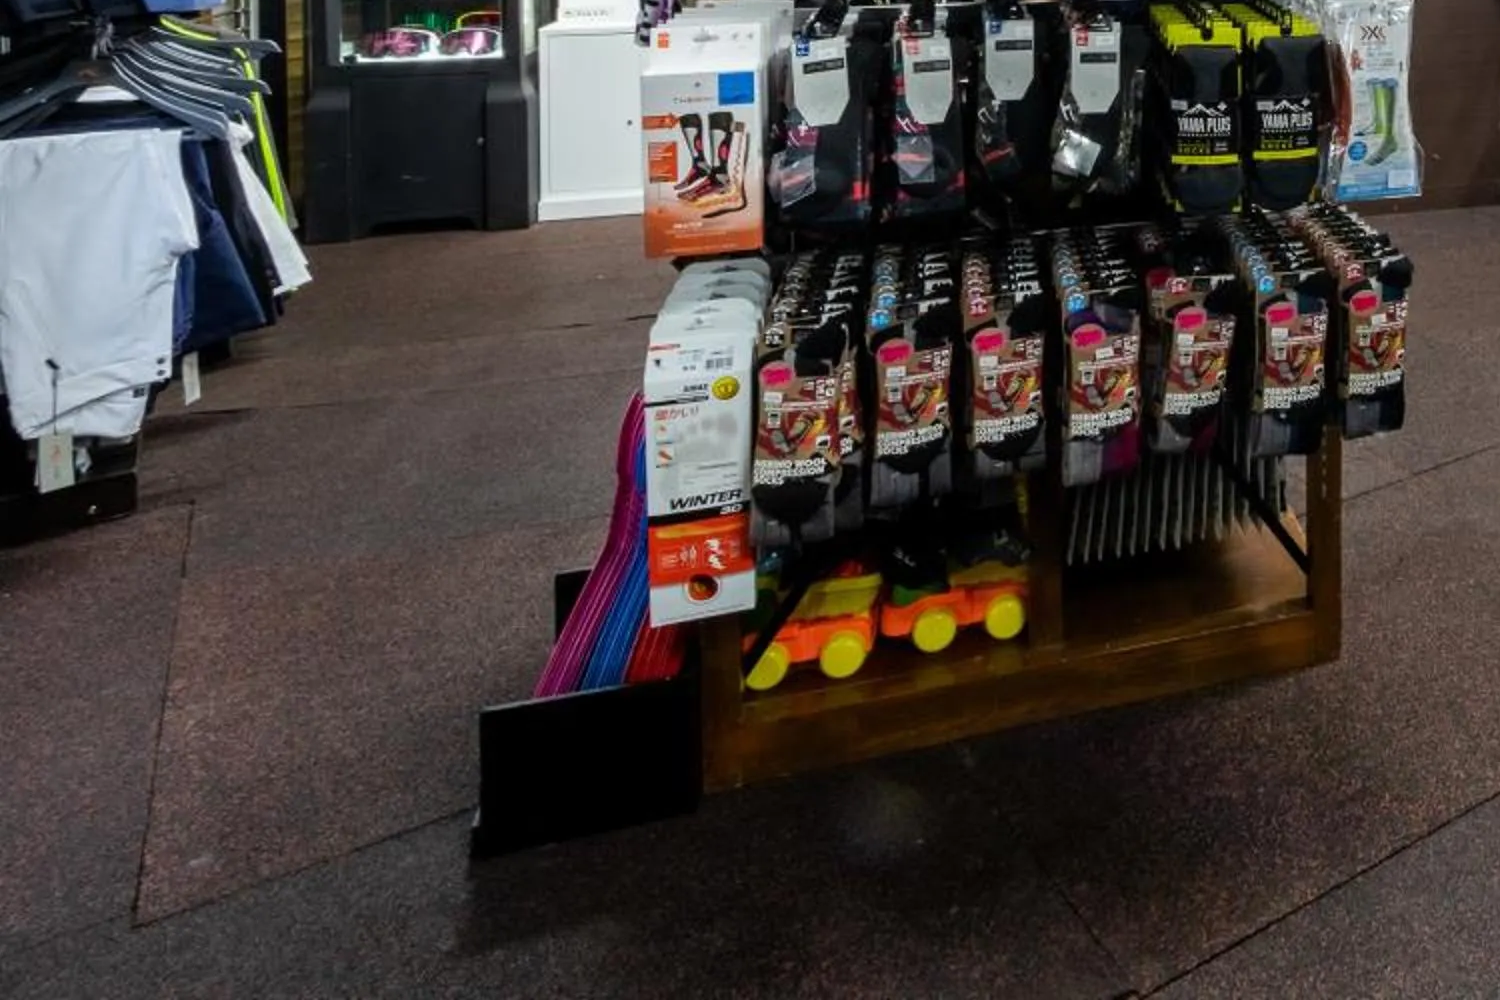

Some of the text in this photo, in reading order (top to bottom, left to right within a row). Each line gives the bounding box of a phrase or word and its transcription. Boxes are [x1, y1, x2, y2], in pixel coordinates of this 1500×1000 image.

[1177, 116, 1231, 133] YAMA PLUS
[1262, 111, 1313, 129] YAMA PLUS
[670, 488, 742, 510] WINTER
